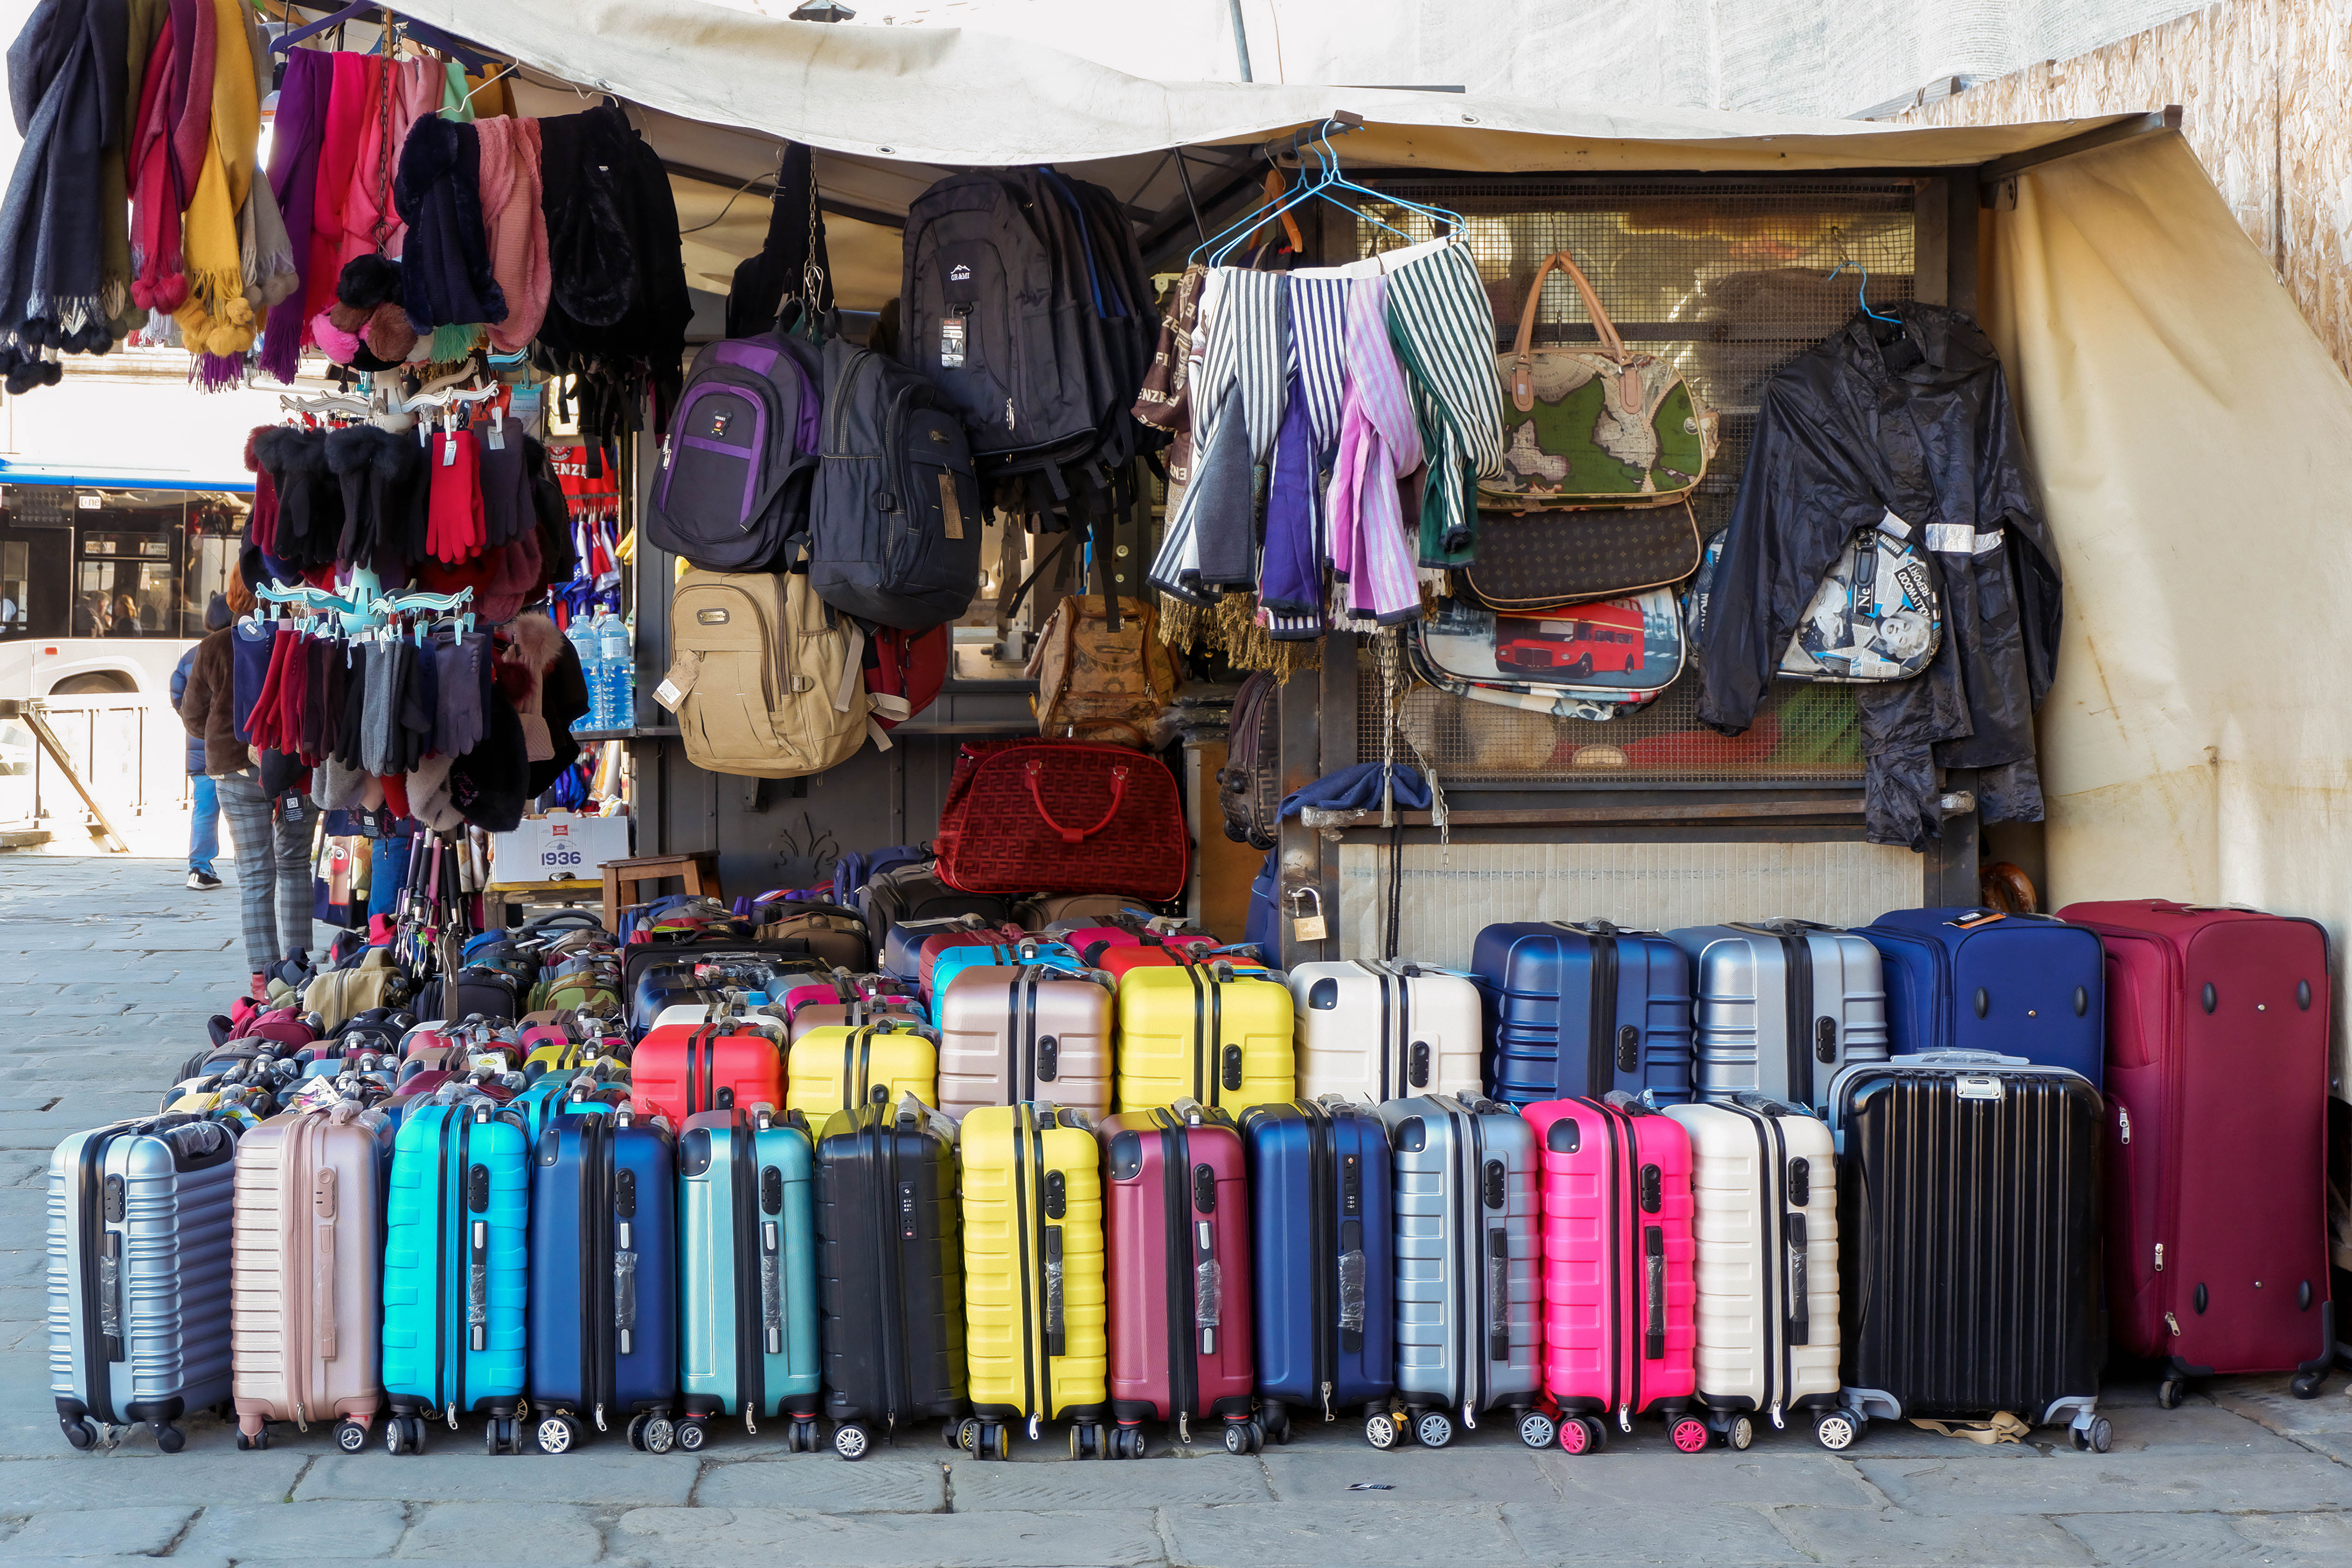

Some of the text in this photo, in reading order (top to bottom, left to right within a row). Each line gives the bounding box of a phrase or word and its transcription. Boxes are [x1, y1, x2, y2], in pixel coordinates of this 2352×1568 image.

[1878, 534, 1903, 554] MARILYN
[1907, 565, 1930, 597] REPORT
[541, 851, 581, 866] 1936
